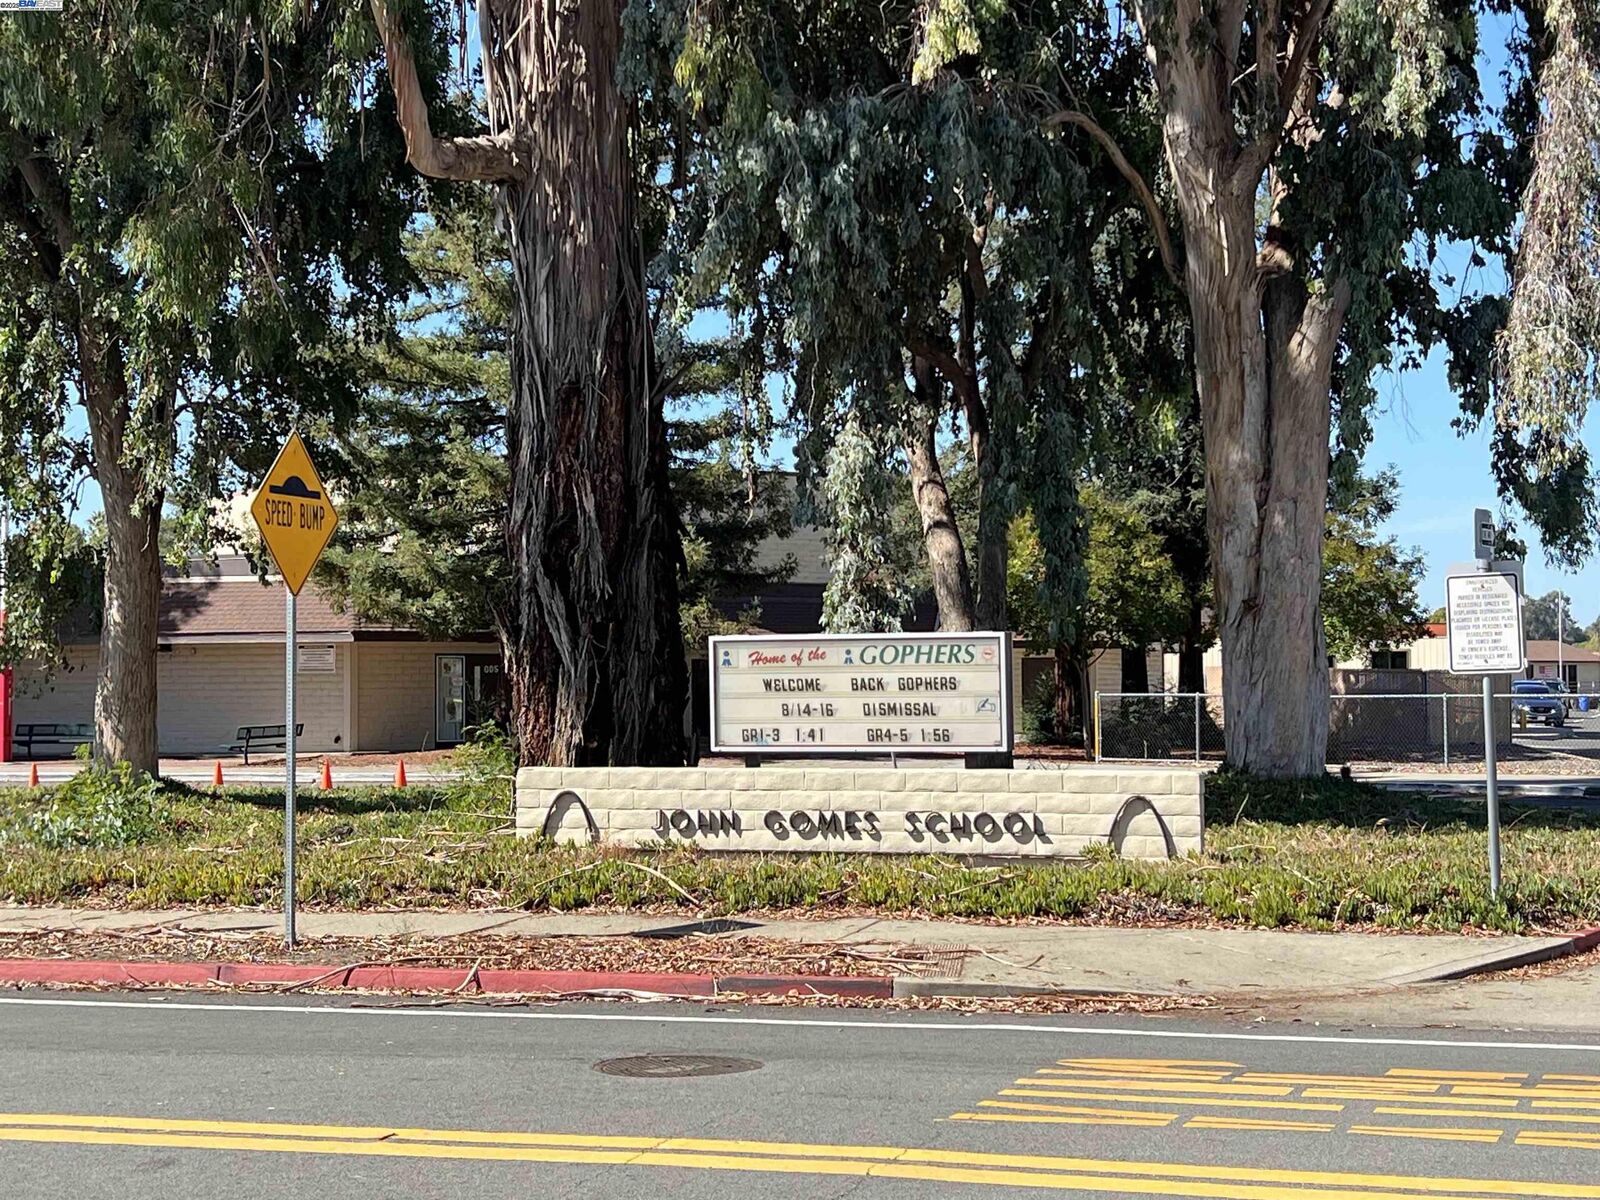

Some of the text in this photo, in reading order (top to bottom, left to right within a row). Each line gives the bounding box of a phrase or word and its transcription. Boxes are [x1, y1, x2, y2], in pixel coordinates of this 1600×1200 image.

[265, 498, 325, 531] SPEED BUMP
[748, 646, 827, 666] Home of the
[859, 643, 976, 666] GOPHERS
[763, 676, 958, 693] WELCOME BACK GOPHERS
[781, 702, 937, 718] 8/14-16 DISMISSAL
[795, 727, 824, 743] 1:41
[866, 727, 909, 743] GR4-5
[921, 727, 951, 742] 1:56
[652, 809, 1050, 841] JOHN GOMES SCHOOL
